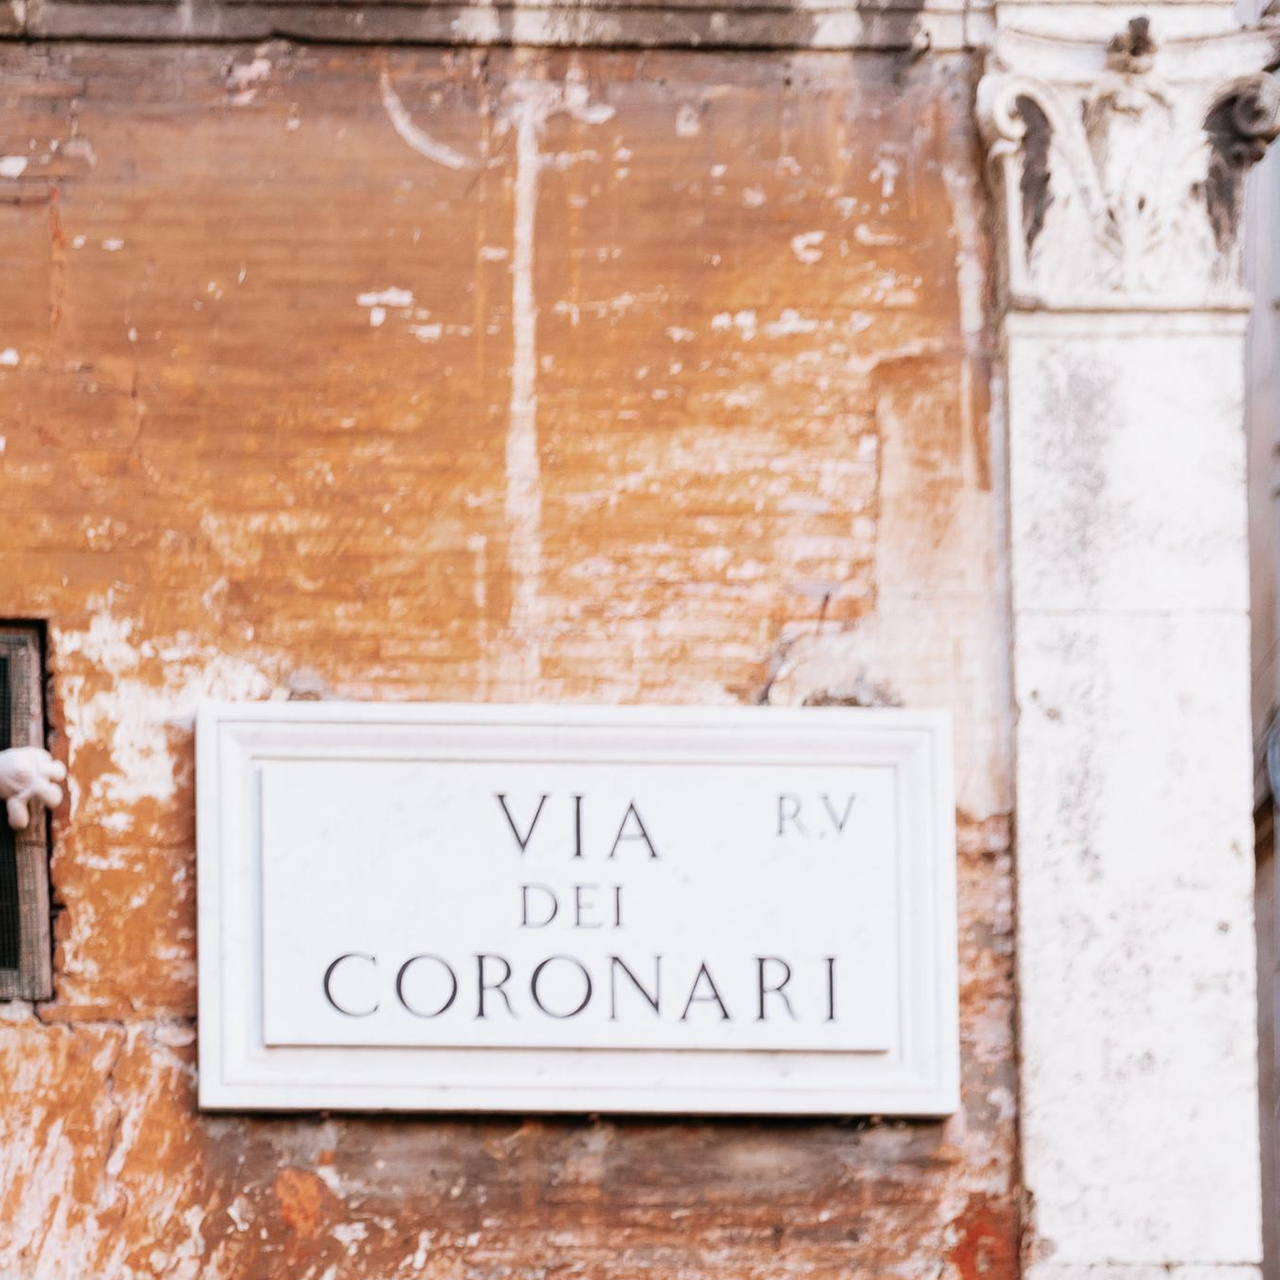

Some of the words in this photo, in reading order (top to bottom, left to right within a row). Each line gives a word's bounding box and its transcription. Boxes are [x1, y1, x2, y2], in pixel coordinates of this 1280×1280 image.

[493, 792, 659, 859] VIA
[519, 883, 623, 928] DEI
[322, 953, 839, 1021] CORONARI
